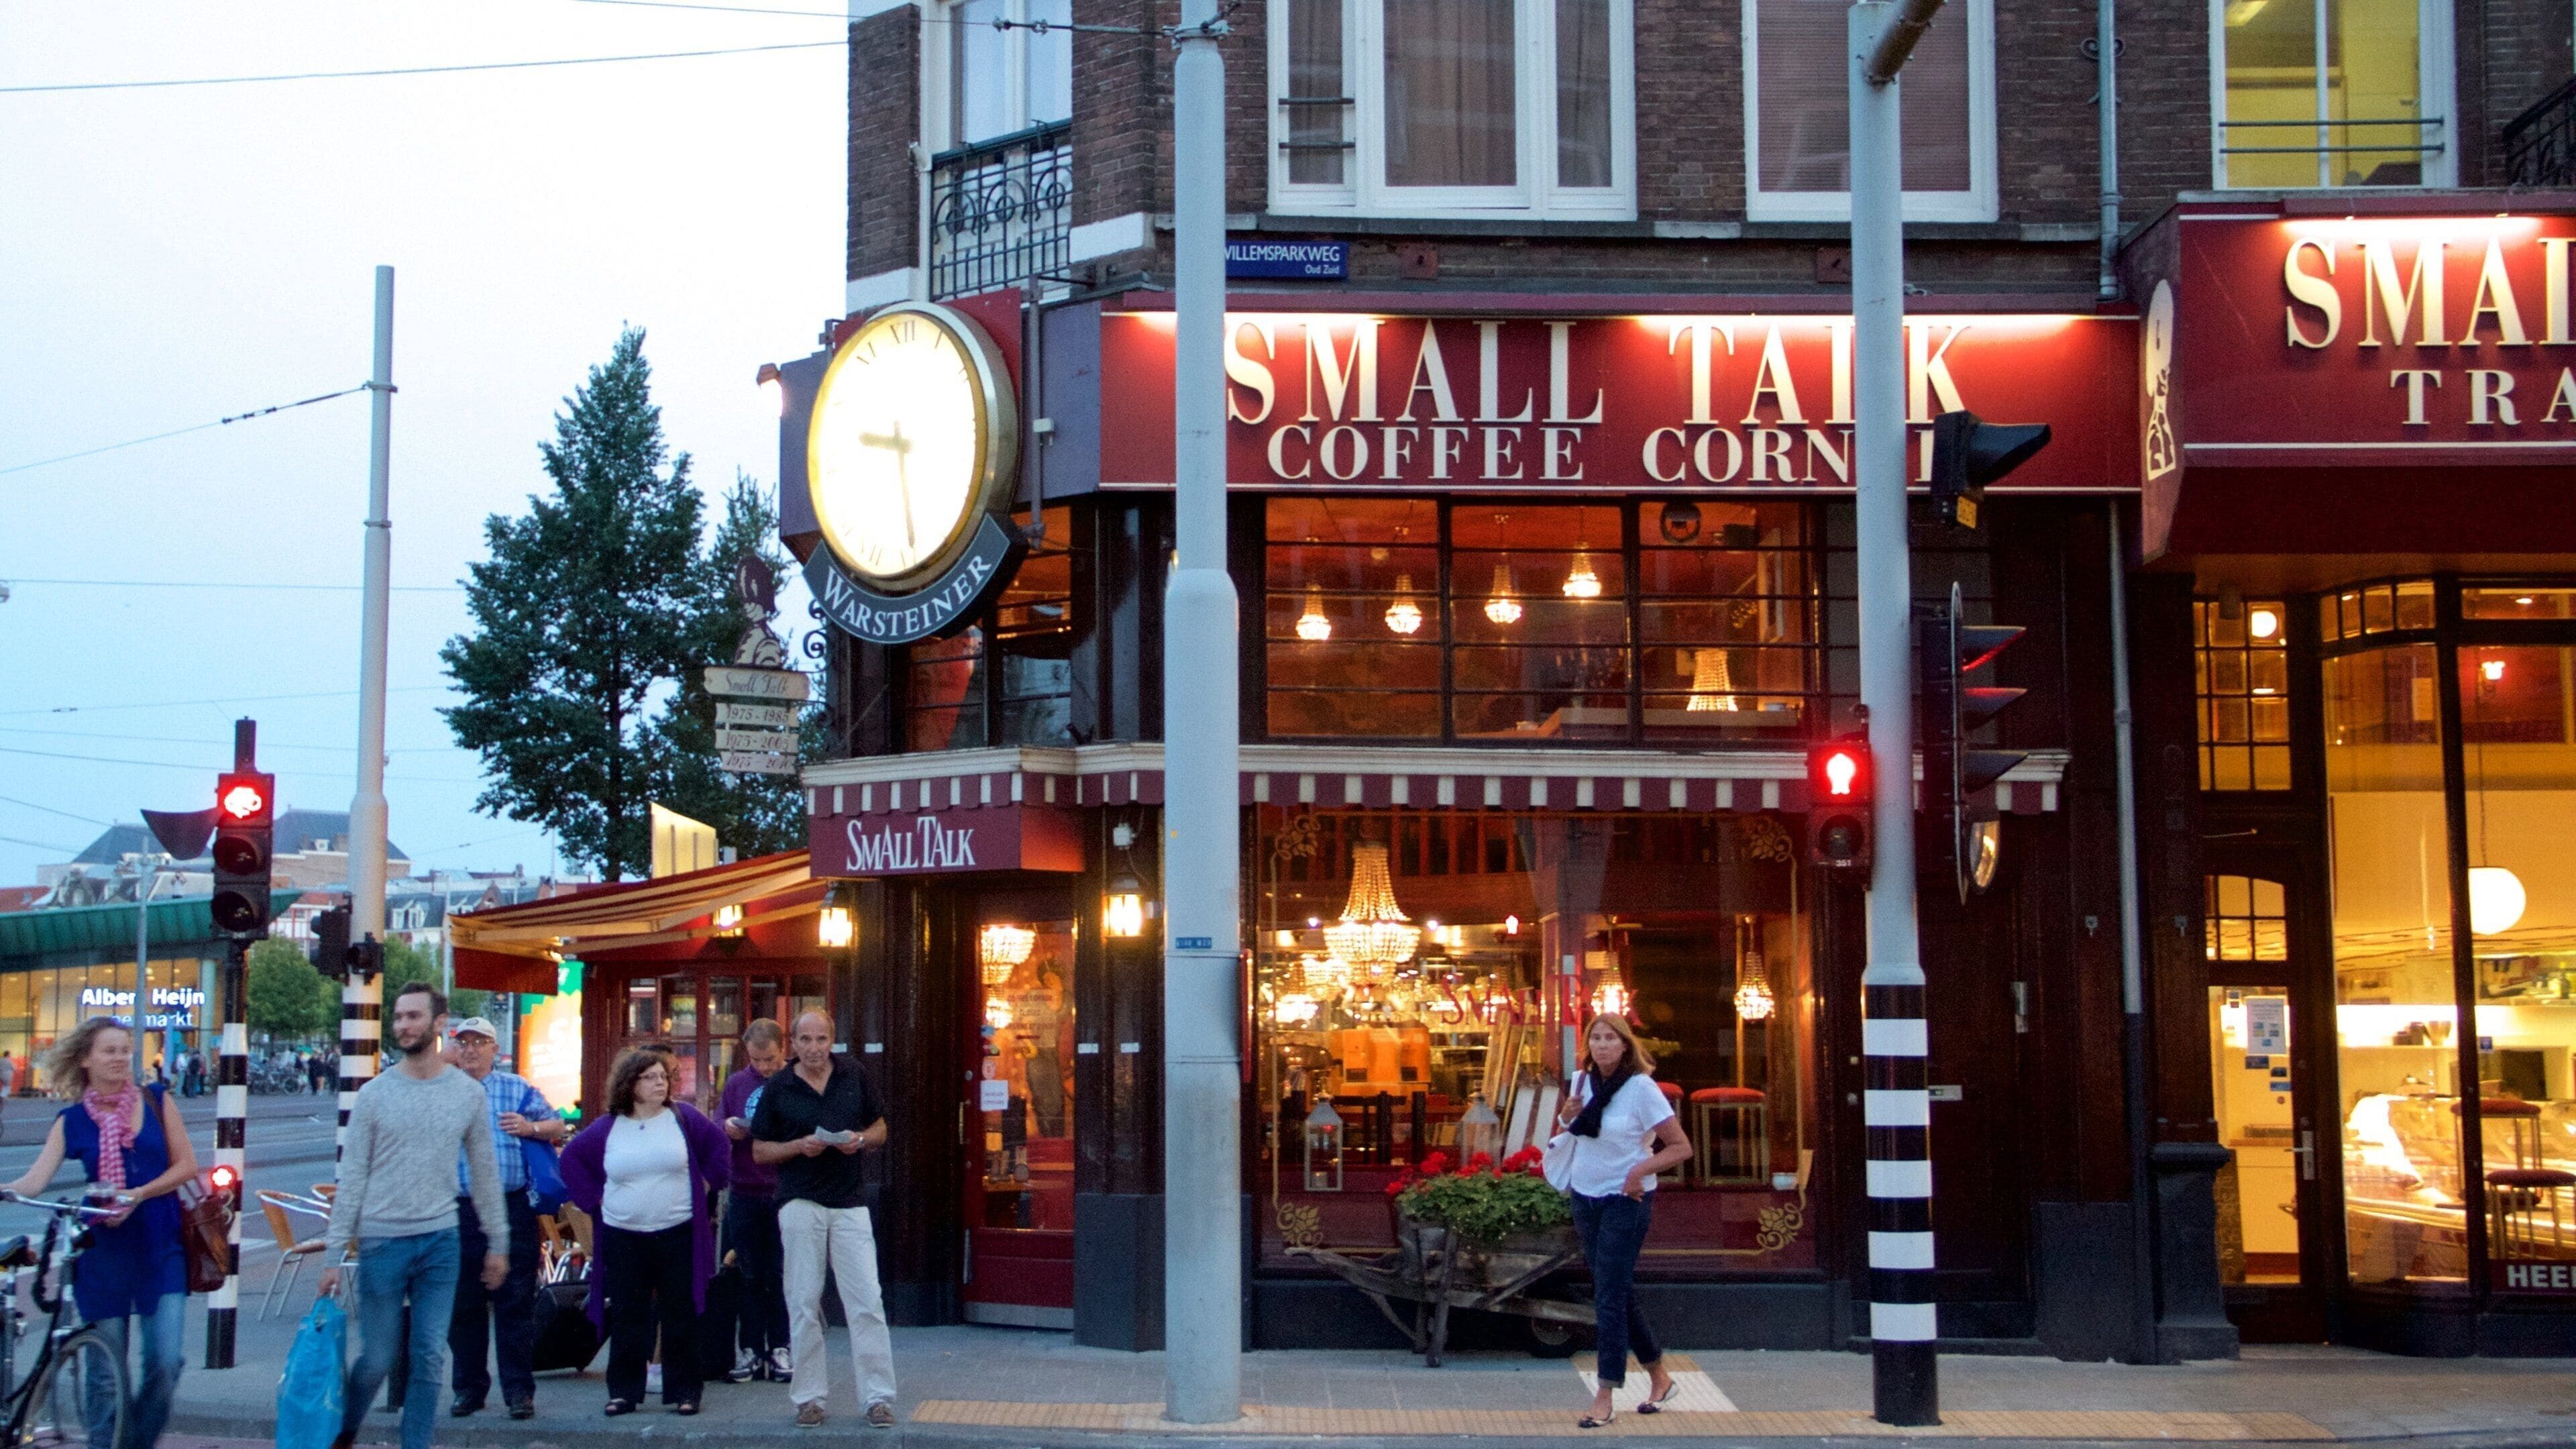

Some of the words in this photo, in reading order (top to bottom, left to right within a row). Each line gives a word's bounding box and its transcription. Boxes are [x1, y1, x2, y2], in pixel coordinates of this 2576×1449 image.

[1224, 318, 1603, 424] SMALL
[1268, 425, 1583, 480] COFFEE
[1642, 427, 1935, 482] CORN
[823, 554, 992, 638] WARSTEINER
[847, 819, 918, 871] SMALL
[917, 816, 976, 868] TALK
[82, 988, 137, 1006] Alber
[152, 987, 205, 1008] Heijn
